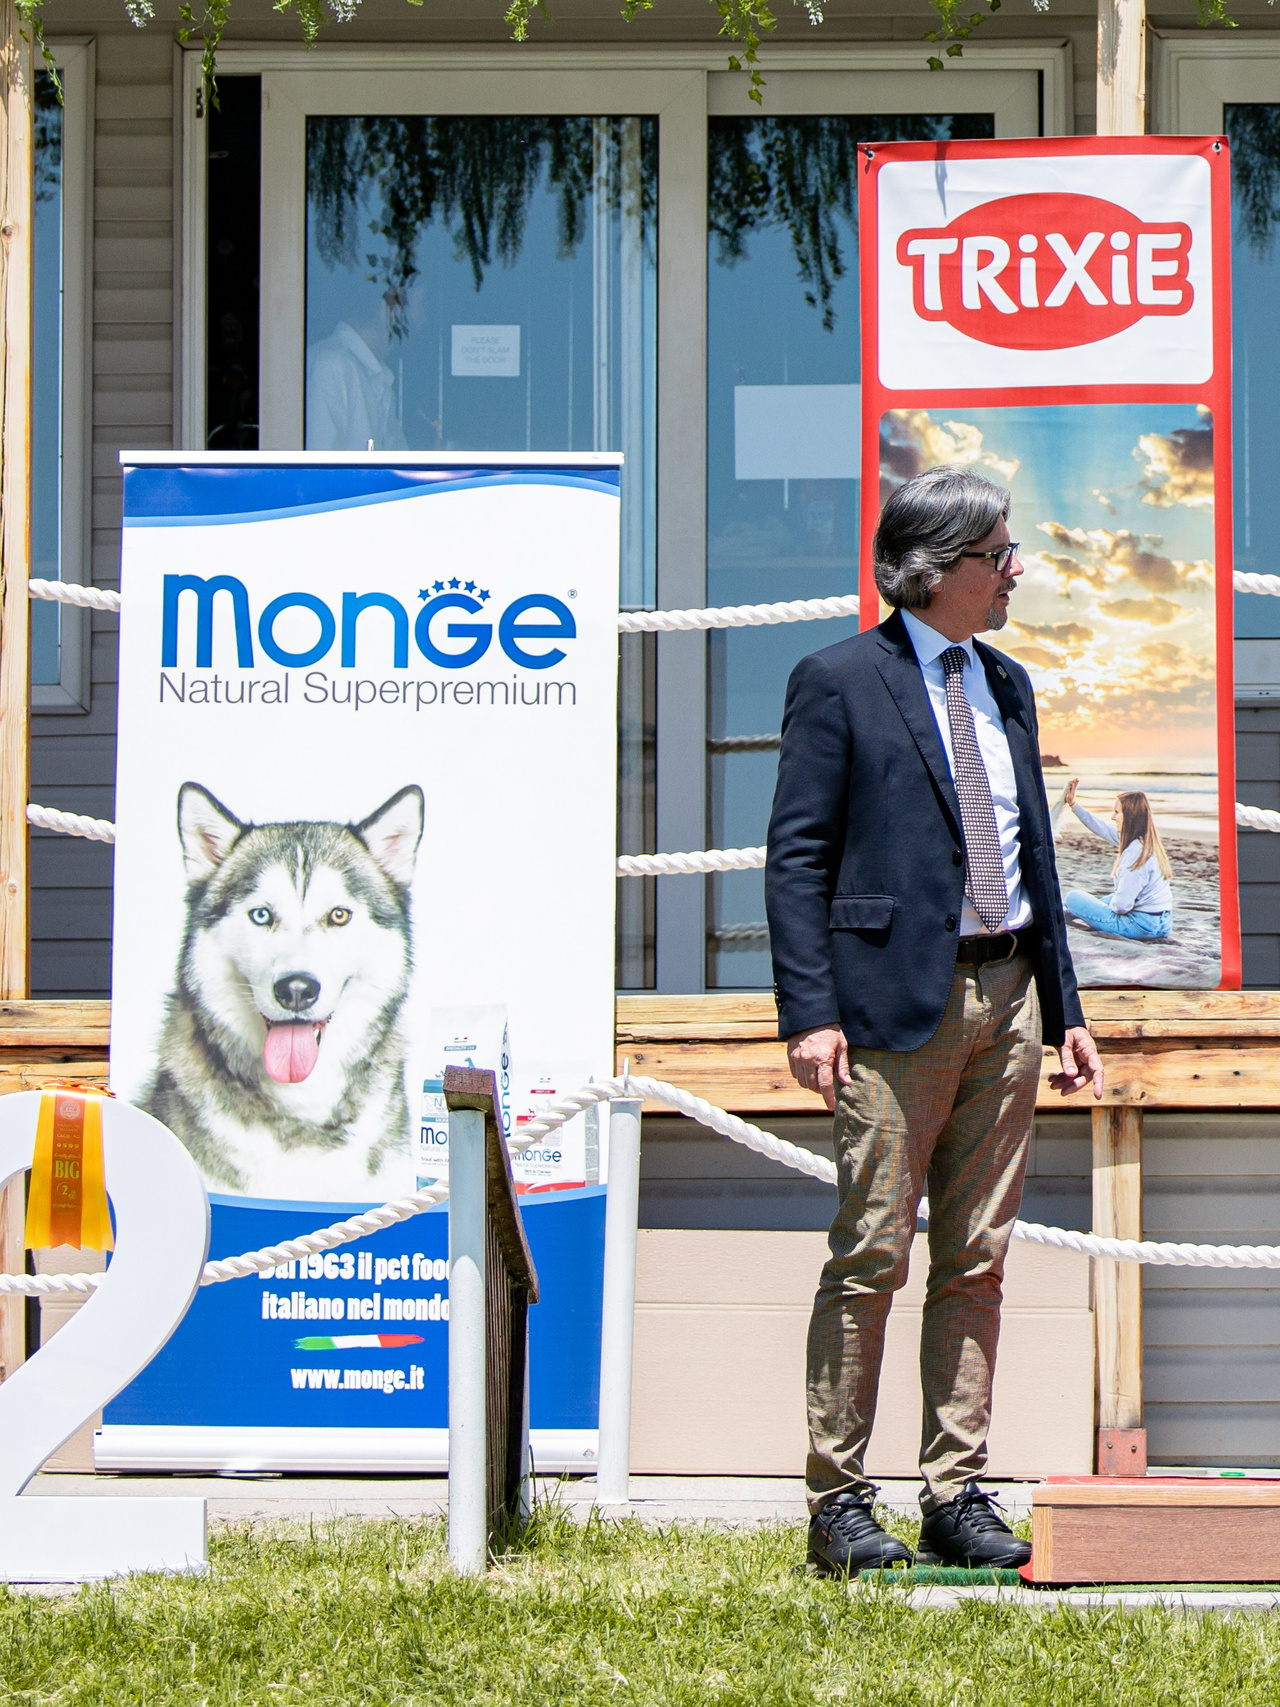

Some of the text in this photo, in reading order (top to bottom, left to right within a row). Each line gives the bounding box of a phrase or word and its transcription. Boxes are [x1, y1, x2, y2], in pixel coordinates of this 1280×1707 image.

[159, 671, 577, 712] Natural Superpremium
[55, 1160, 80, 1179] BIG
[62, 1184, 68, 1196] 2
[299, 1252, 355, 1281] 1963
[357, 1251, 373, 1280] il
[375, 1254, 410, 1285] pet
[412, 1253, 449, 1281] foo
[261, 1291, 345, 1320] italiano
[346, 1292, 381, 1320] nel
[290, 1364, 425, 1394] www.monge.it
